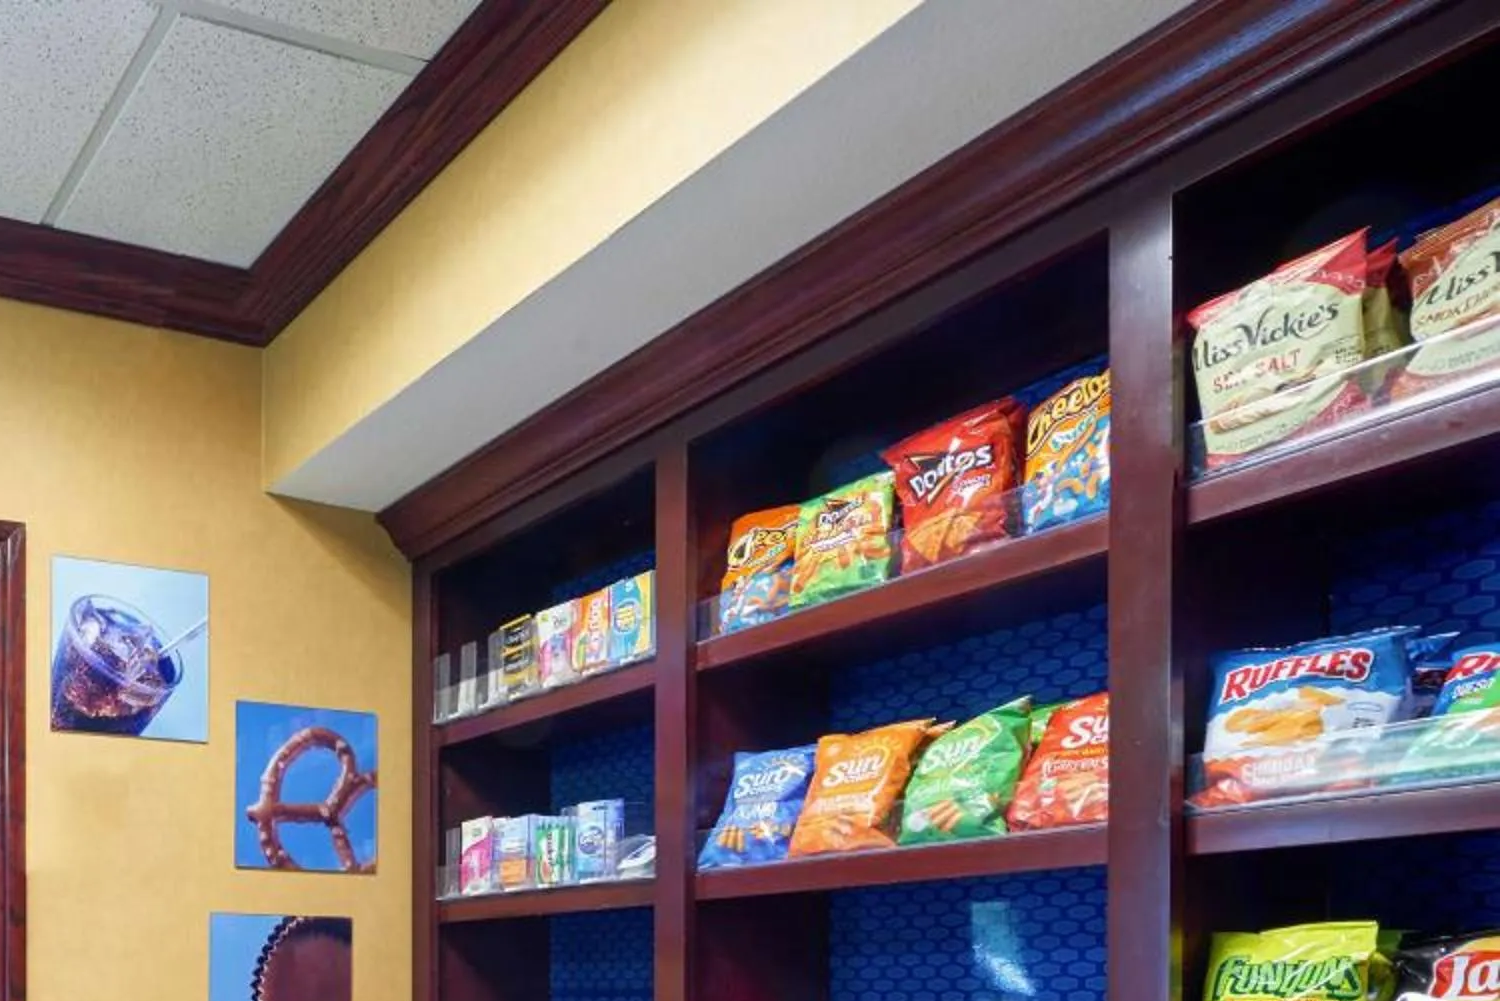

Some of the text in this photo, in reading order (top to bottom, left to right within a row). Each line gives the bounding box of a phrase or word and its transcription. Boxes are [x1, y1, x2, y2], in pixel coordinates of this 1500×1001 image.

[1233, 303, 1340, 346] Vickie's
[909, 437, 993, 498] Doritos
[1222, 649, 1373, 702] RUFFLES
[1061, 715, 1108, 749] Su
[734, 768, 790, 798] Sun
[822, 755, 883, 787] Sun
